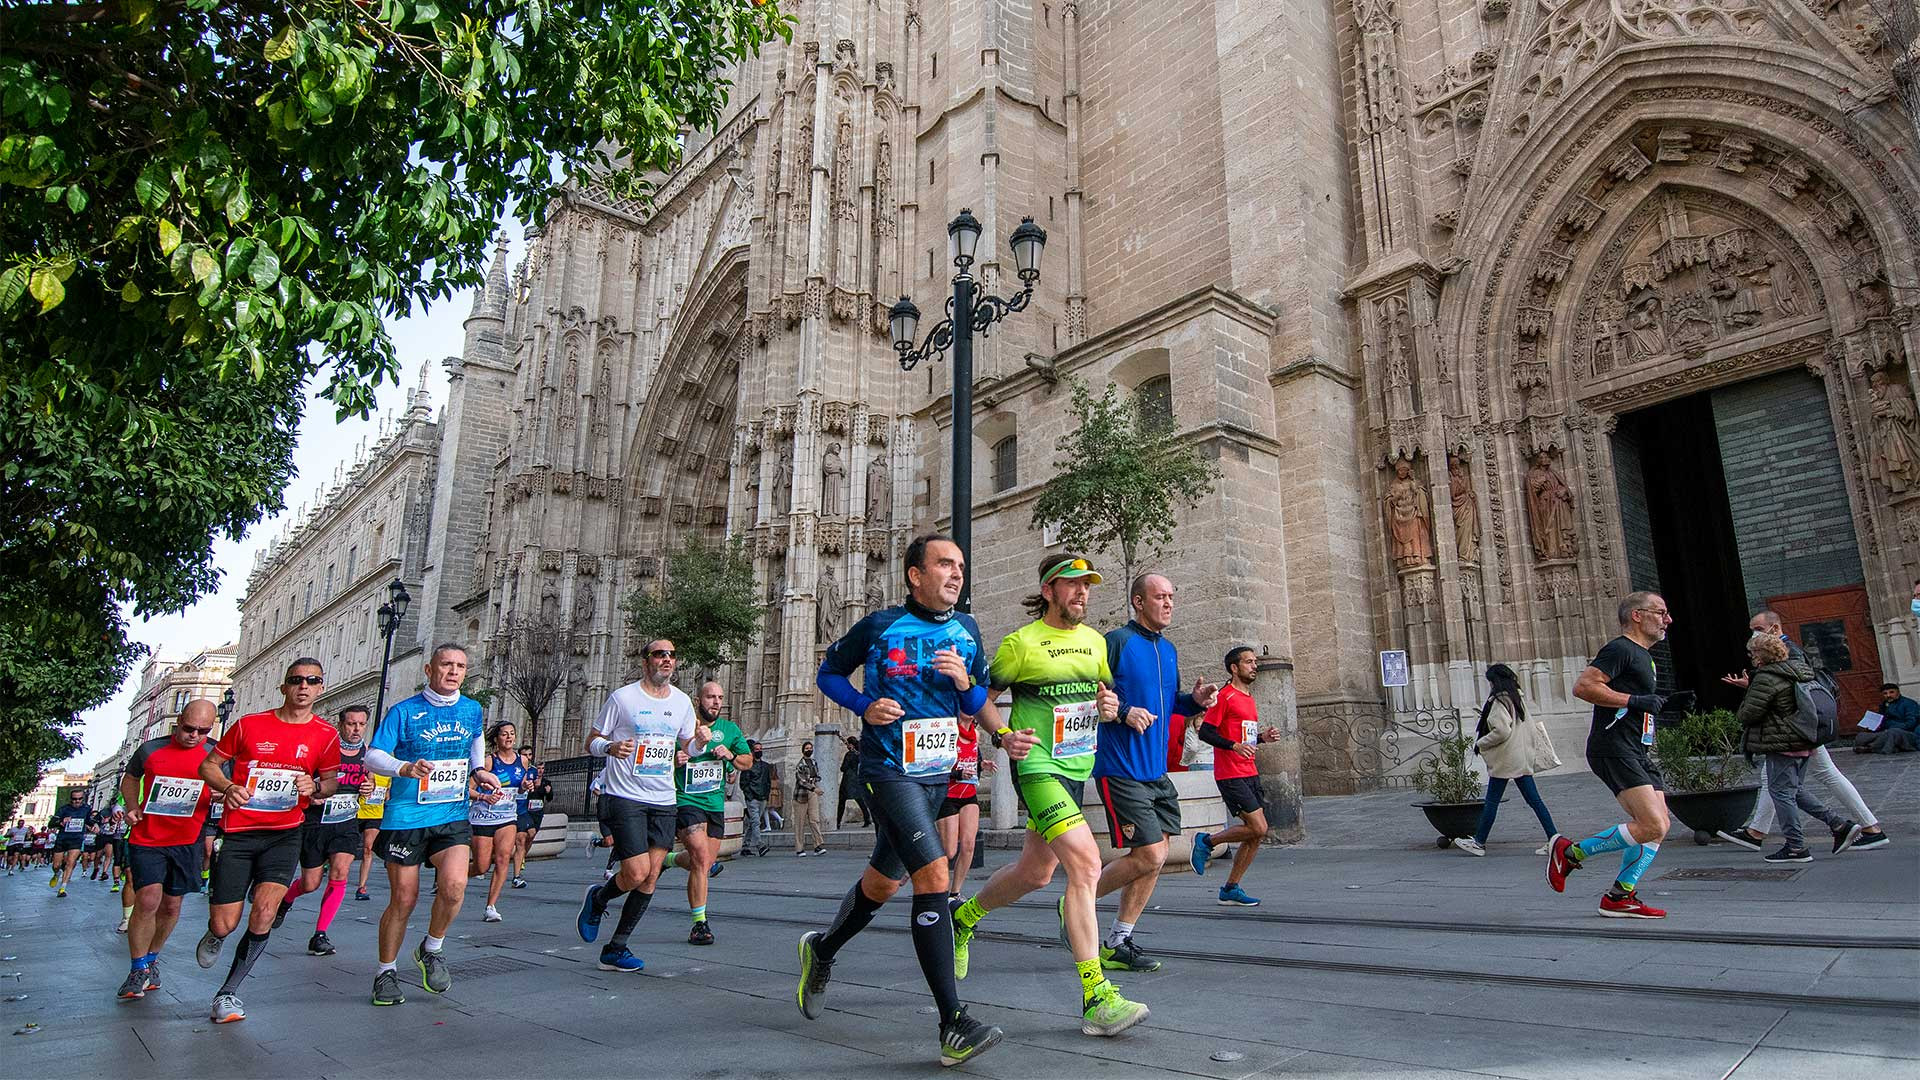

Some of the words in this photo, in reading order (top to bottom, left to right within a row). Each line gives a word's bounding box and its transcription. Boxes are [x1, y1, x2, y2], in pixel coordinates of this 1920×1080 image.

[1065, 715, 1090, 732] 4643
[420, 721, 451, 742] Modas
[453, 720, 473, 739] Ravi
[917, 732, 947, 751] 4532
[645, 747, 668, 759] 5360
[430, 769, 458, 783] 4625
[693, 768, 714, 779] 8978
[161, 785, 190, 799] 7807
[257, 779, 289, 793] 4897
